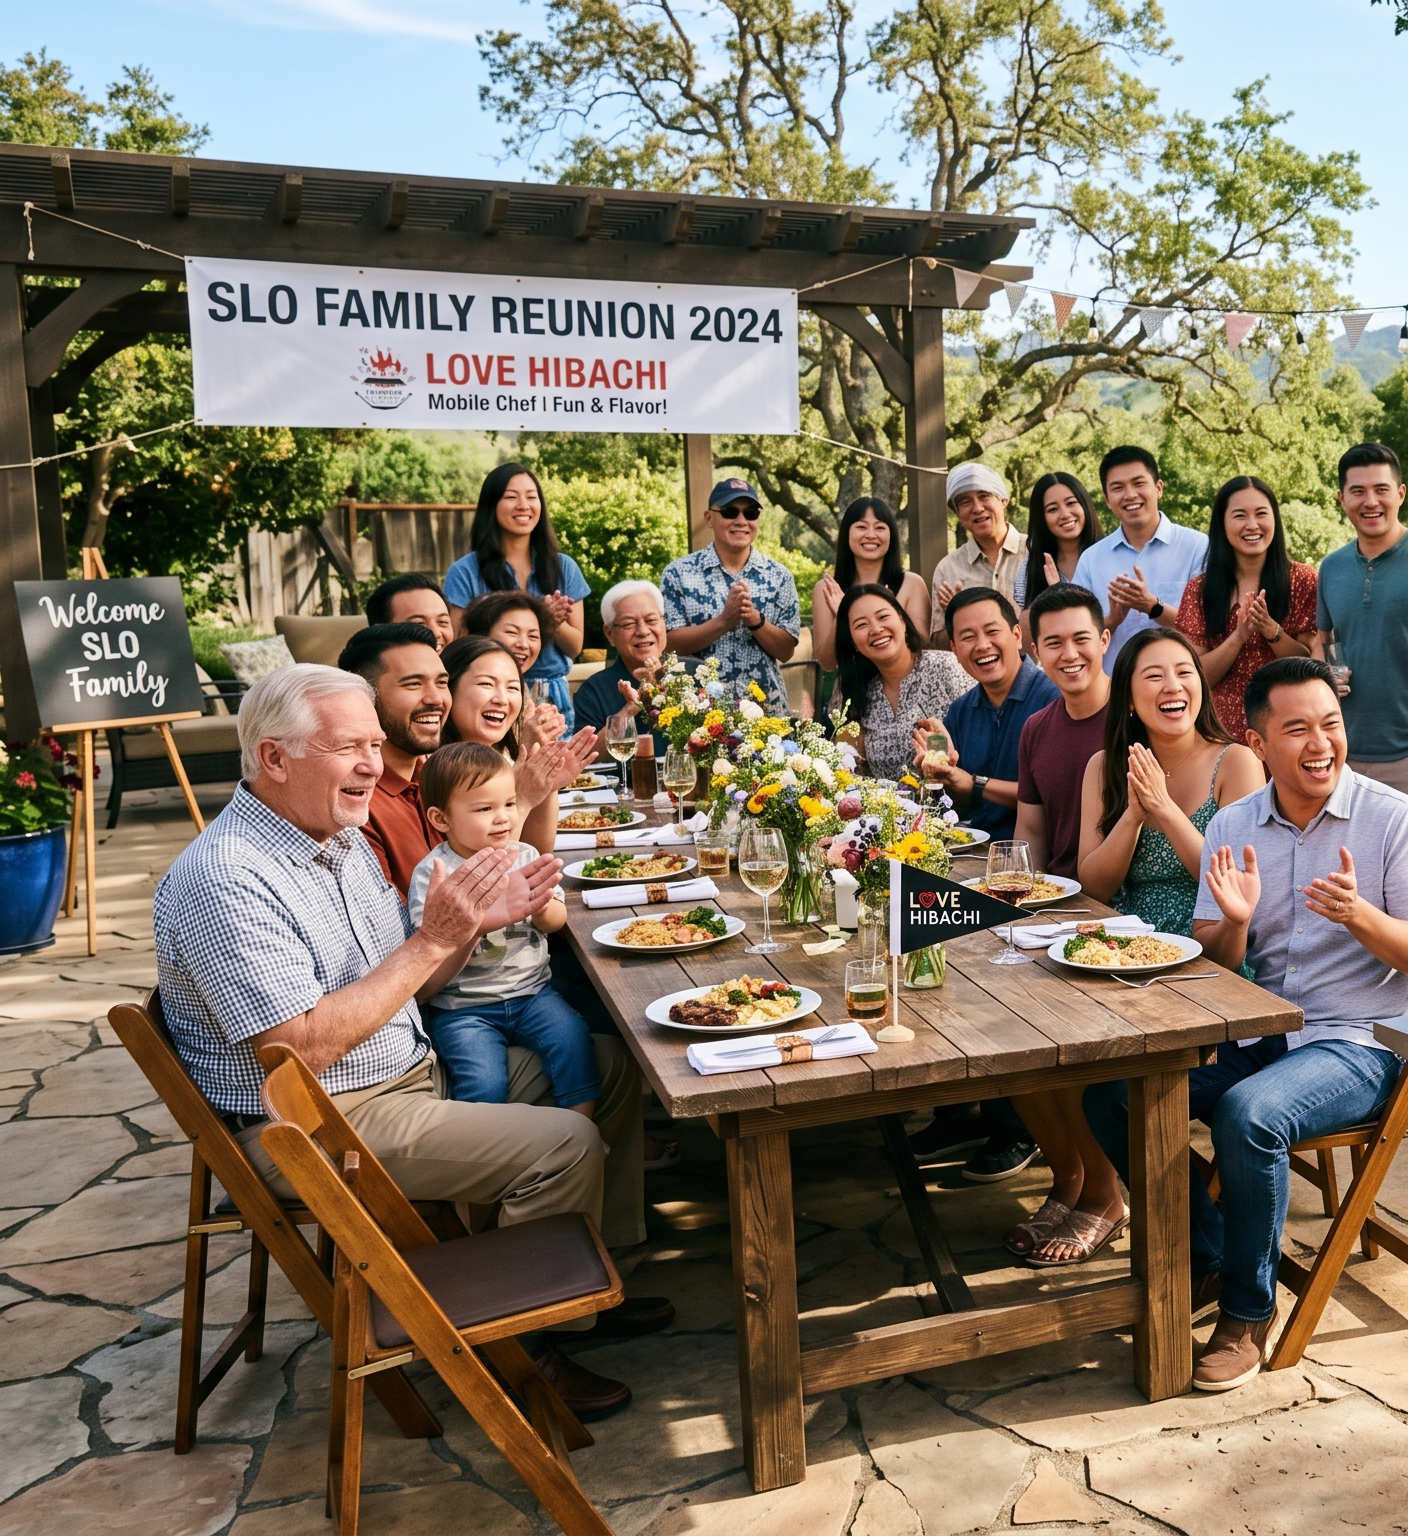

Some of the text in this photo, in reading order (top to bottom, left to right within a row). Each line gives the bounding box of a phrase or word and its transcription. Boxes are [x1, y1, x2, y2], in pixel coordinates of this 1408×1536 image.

[207, 281, 783, 344] SLO FAMILY REUNION 2024
[426, 353, 667, 391] LOVE HIBACHI
[428, 393, 490, 412] Mobile
[496, 395, 536, 413] Chef
[553, 396, 585, 413] Fun
[590, 397, 604, 413] &
[609, 397, 667, 415] Flavor!
[38, 592, 165, 628] Welcome
[81, 630, 140, 661] SLO
[65, 660, 169, 708] Family
[910, 910, 980, 925] HIBACHI
